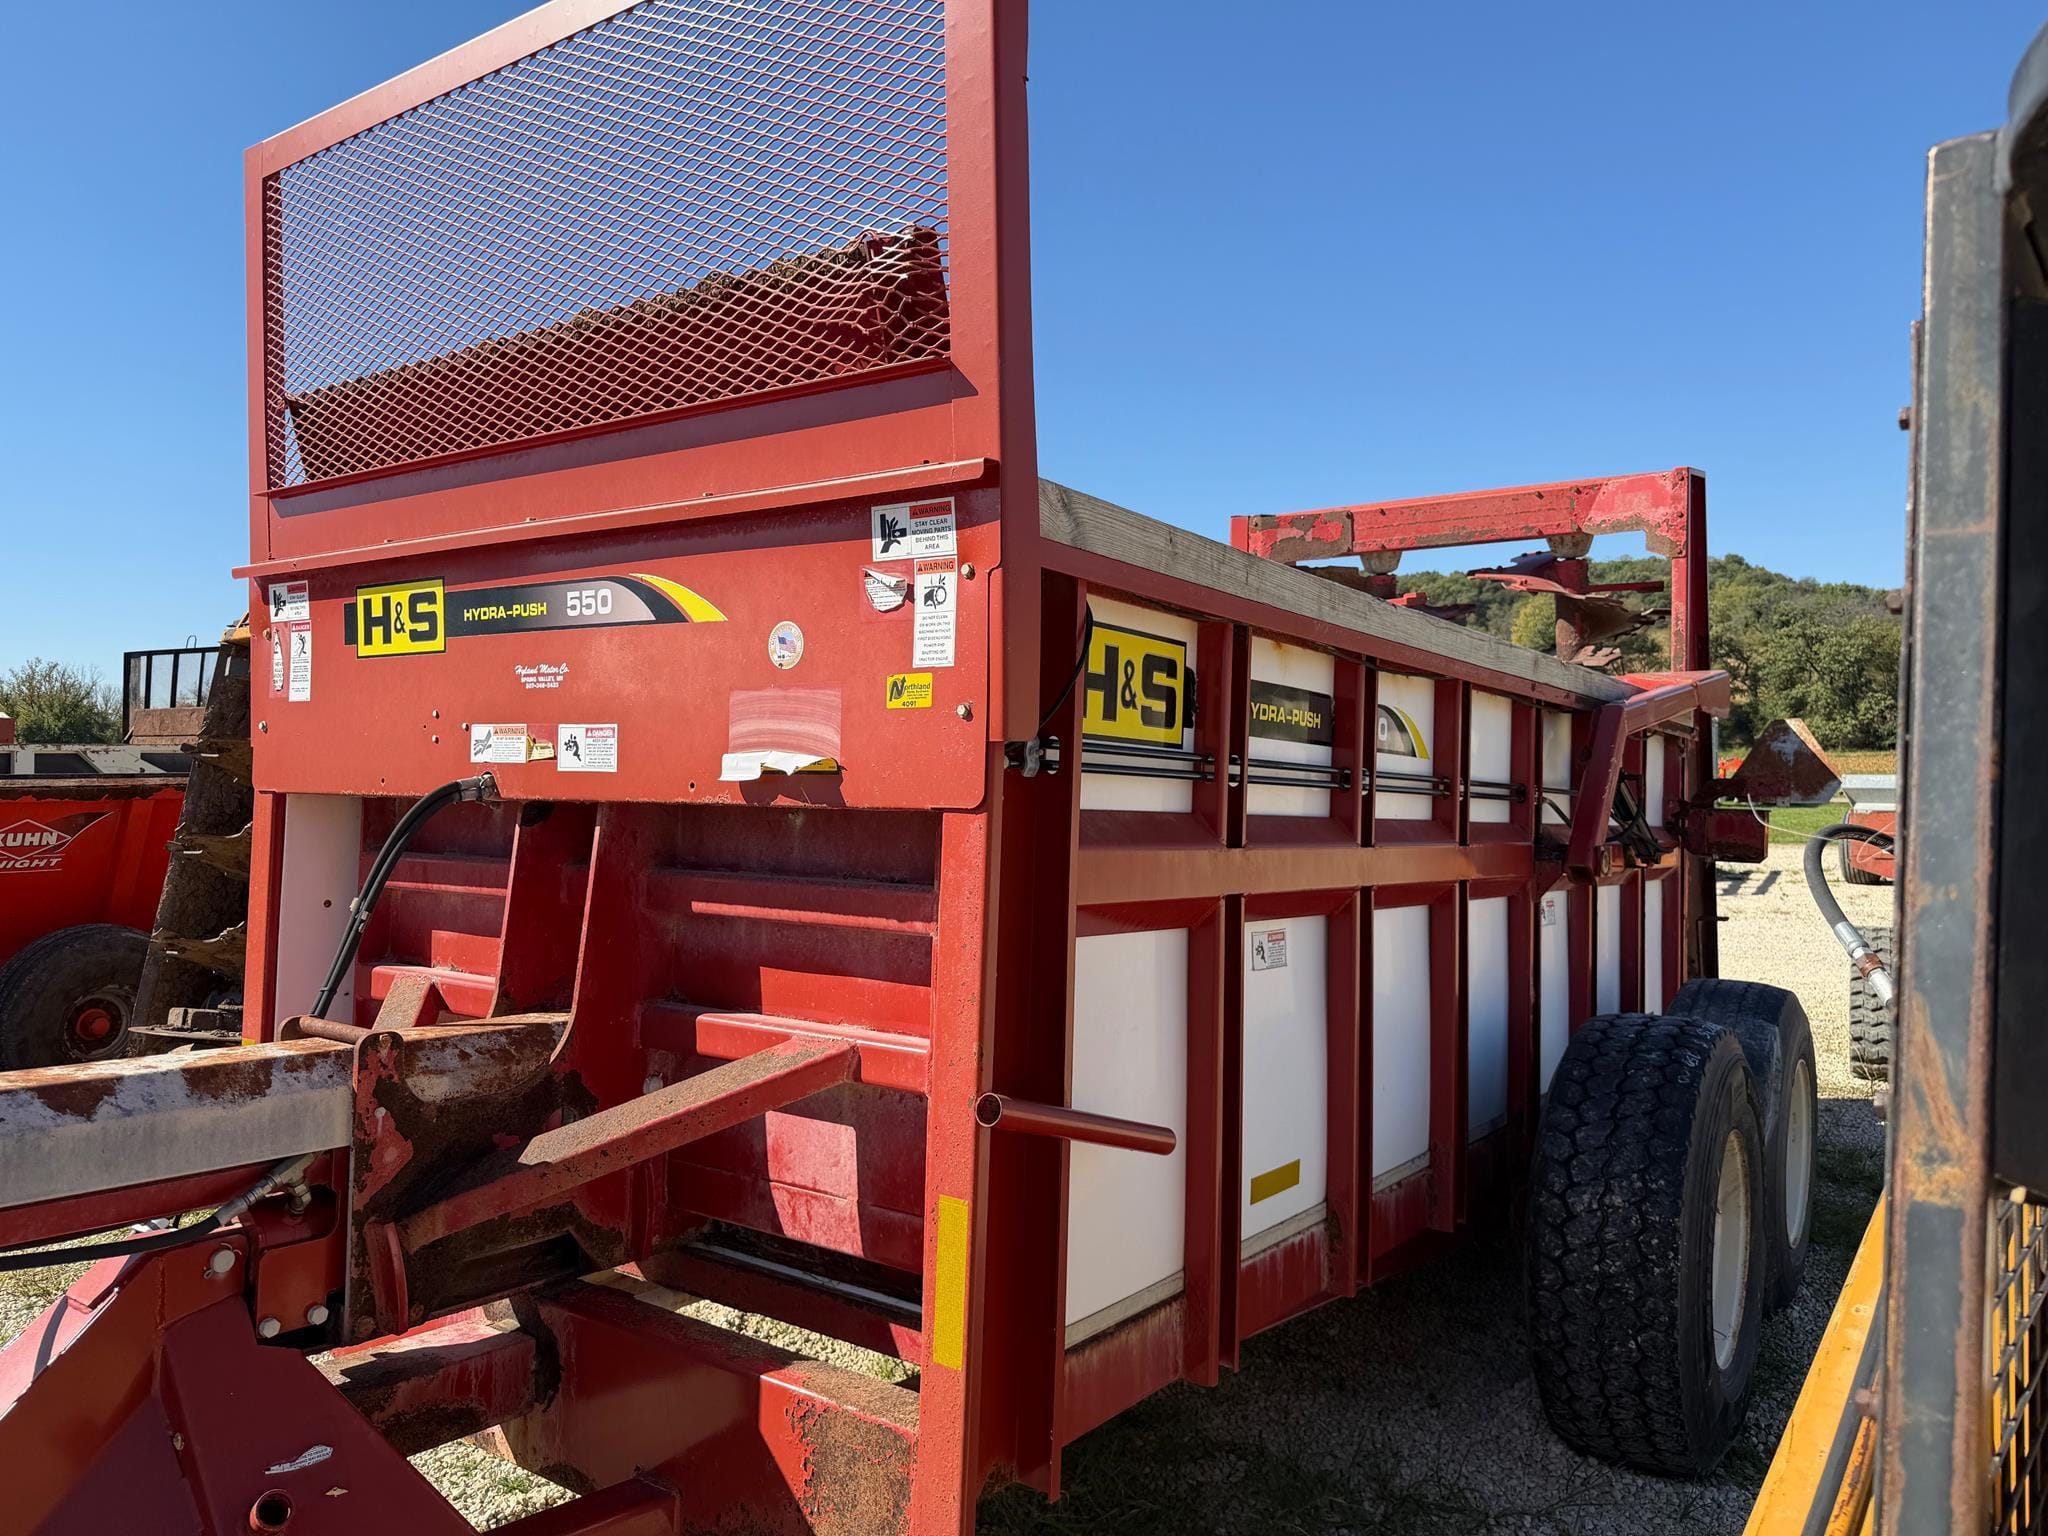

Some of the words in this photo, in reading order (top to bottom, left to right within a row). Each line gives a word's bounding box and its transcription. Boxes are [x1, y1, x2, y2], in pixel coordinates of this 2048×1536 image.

[918, 504, 951, 514] WARNING
[930, 518, 948, 526] CLEAR
[912, 528, 933, 536] MOVING
[934, 526, 952, 534] PARTS
[916, 535, 936, 543] BEHIND
[922, 561, 954, 571] WARNING
[363, 591, 438, 646] H&S
[463, 602, 547, 621] HYDRA-PUSH
[566, 588, 612, 617] 550
[1083, 645, 1178, 730] H&S
